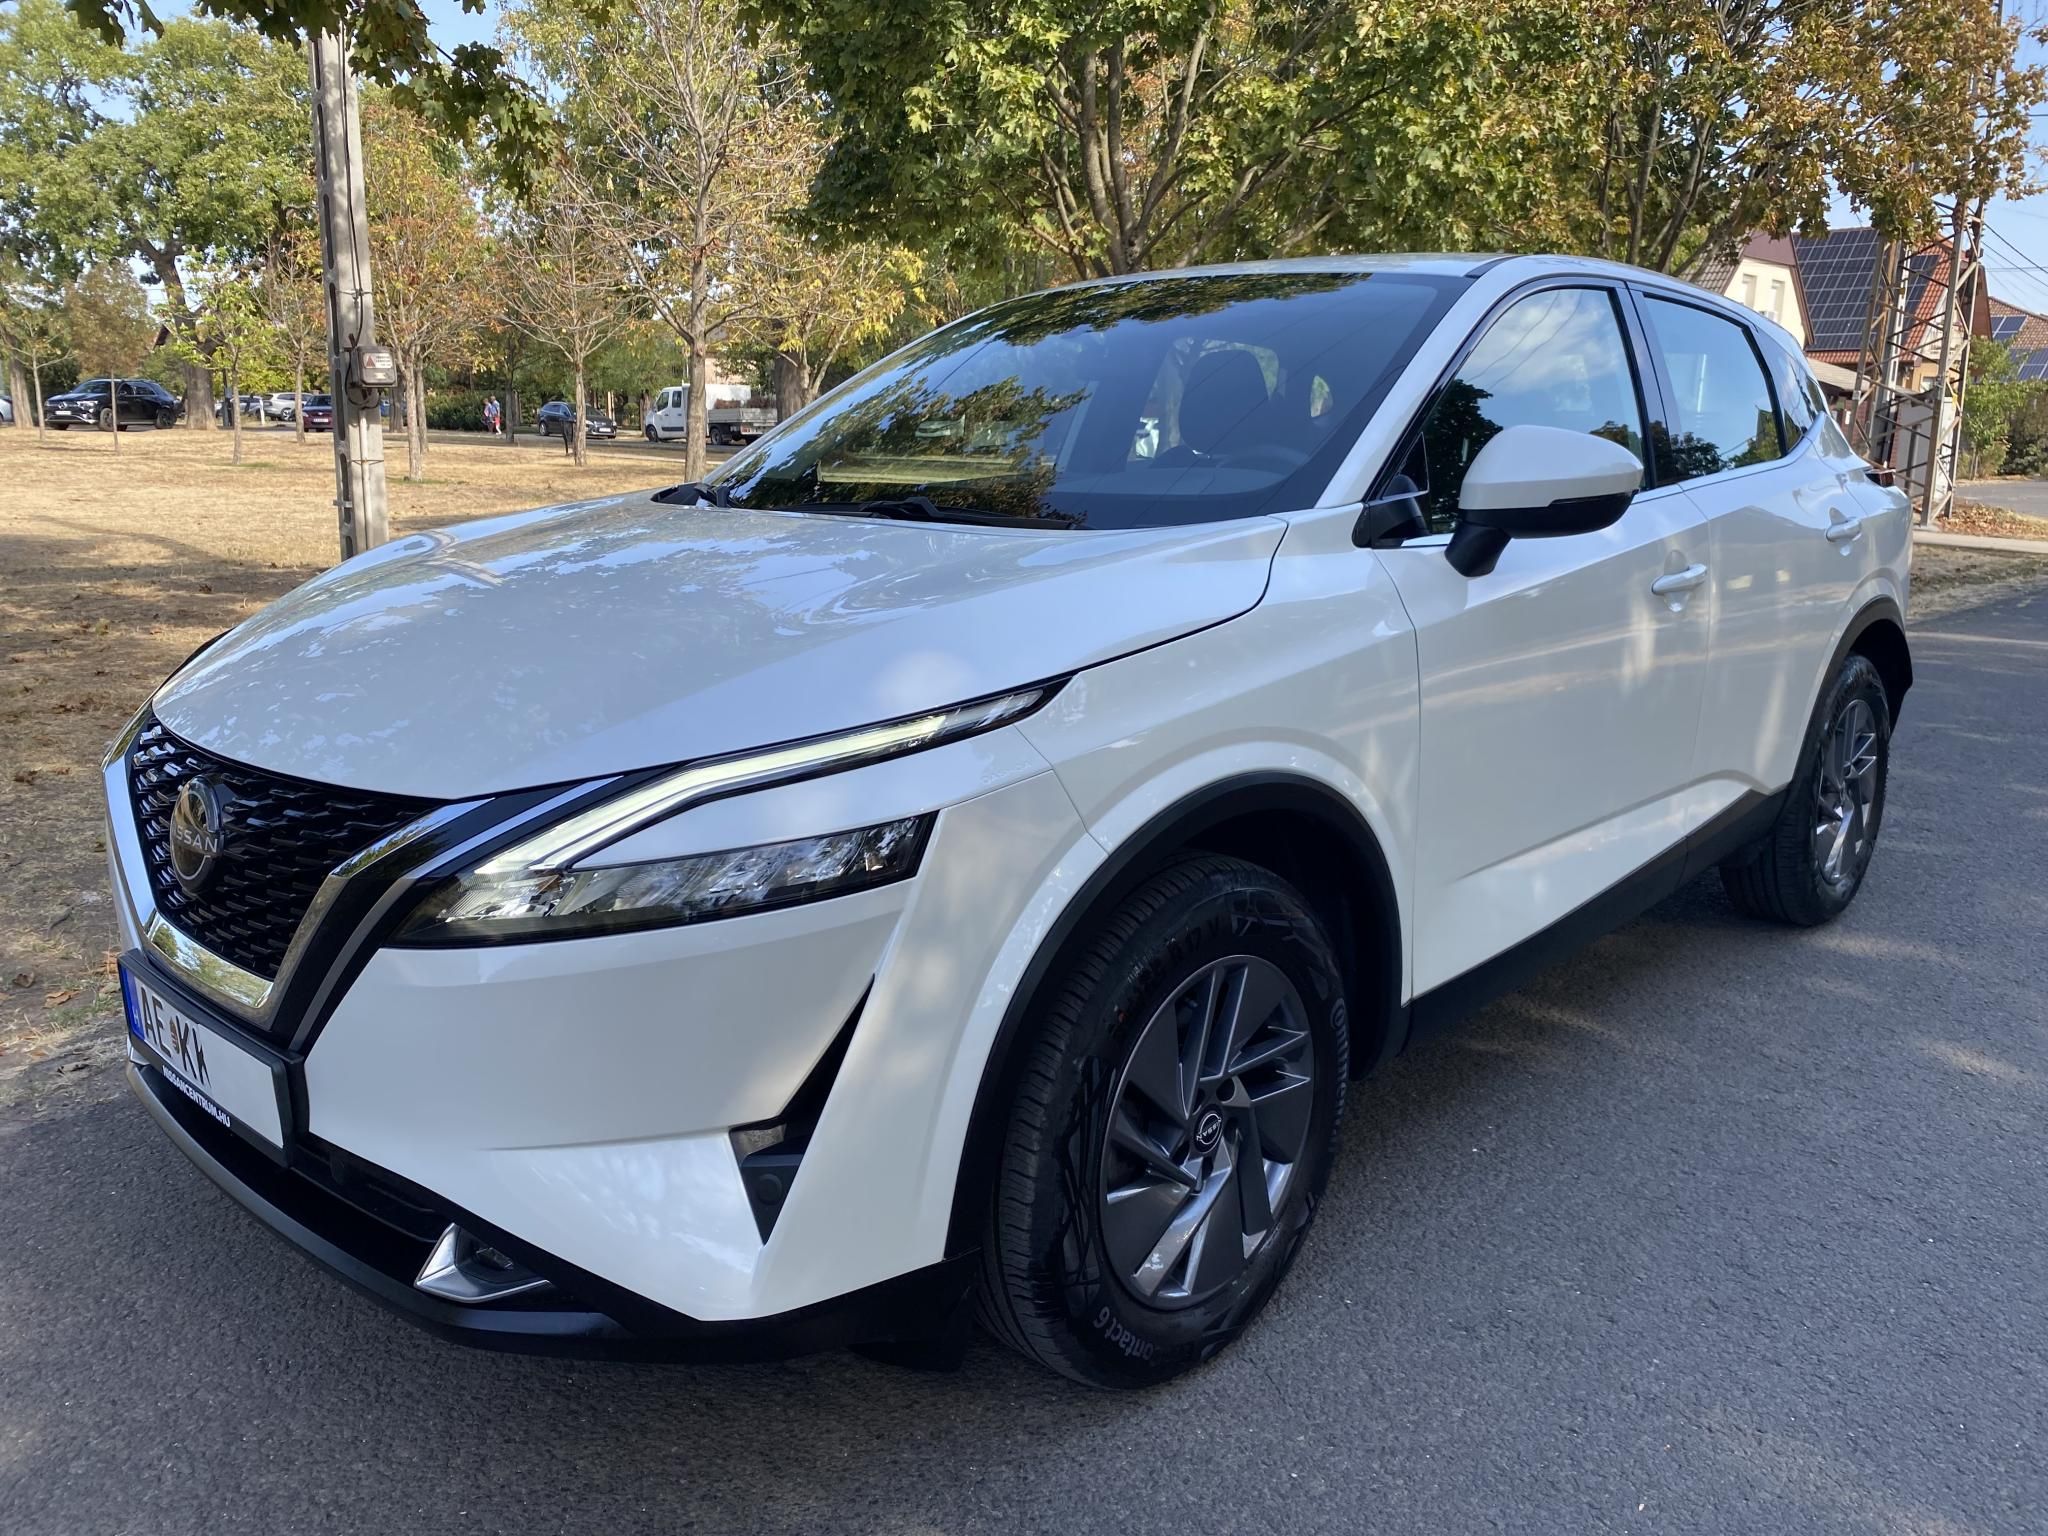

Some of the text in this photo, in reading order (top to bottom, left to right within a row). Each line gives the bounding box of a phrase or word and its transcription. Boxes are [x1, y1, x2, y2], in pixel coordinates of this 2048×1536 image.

[173, 824, 219, 854] SSAN
[141, 986, 172, 1058] AE
[1092, 1305, 1111, 1329] 6
